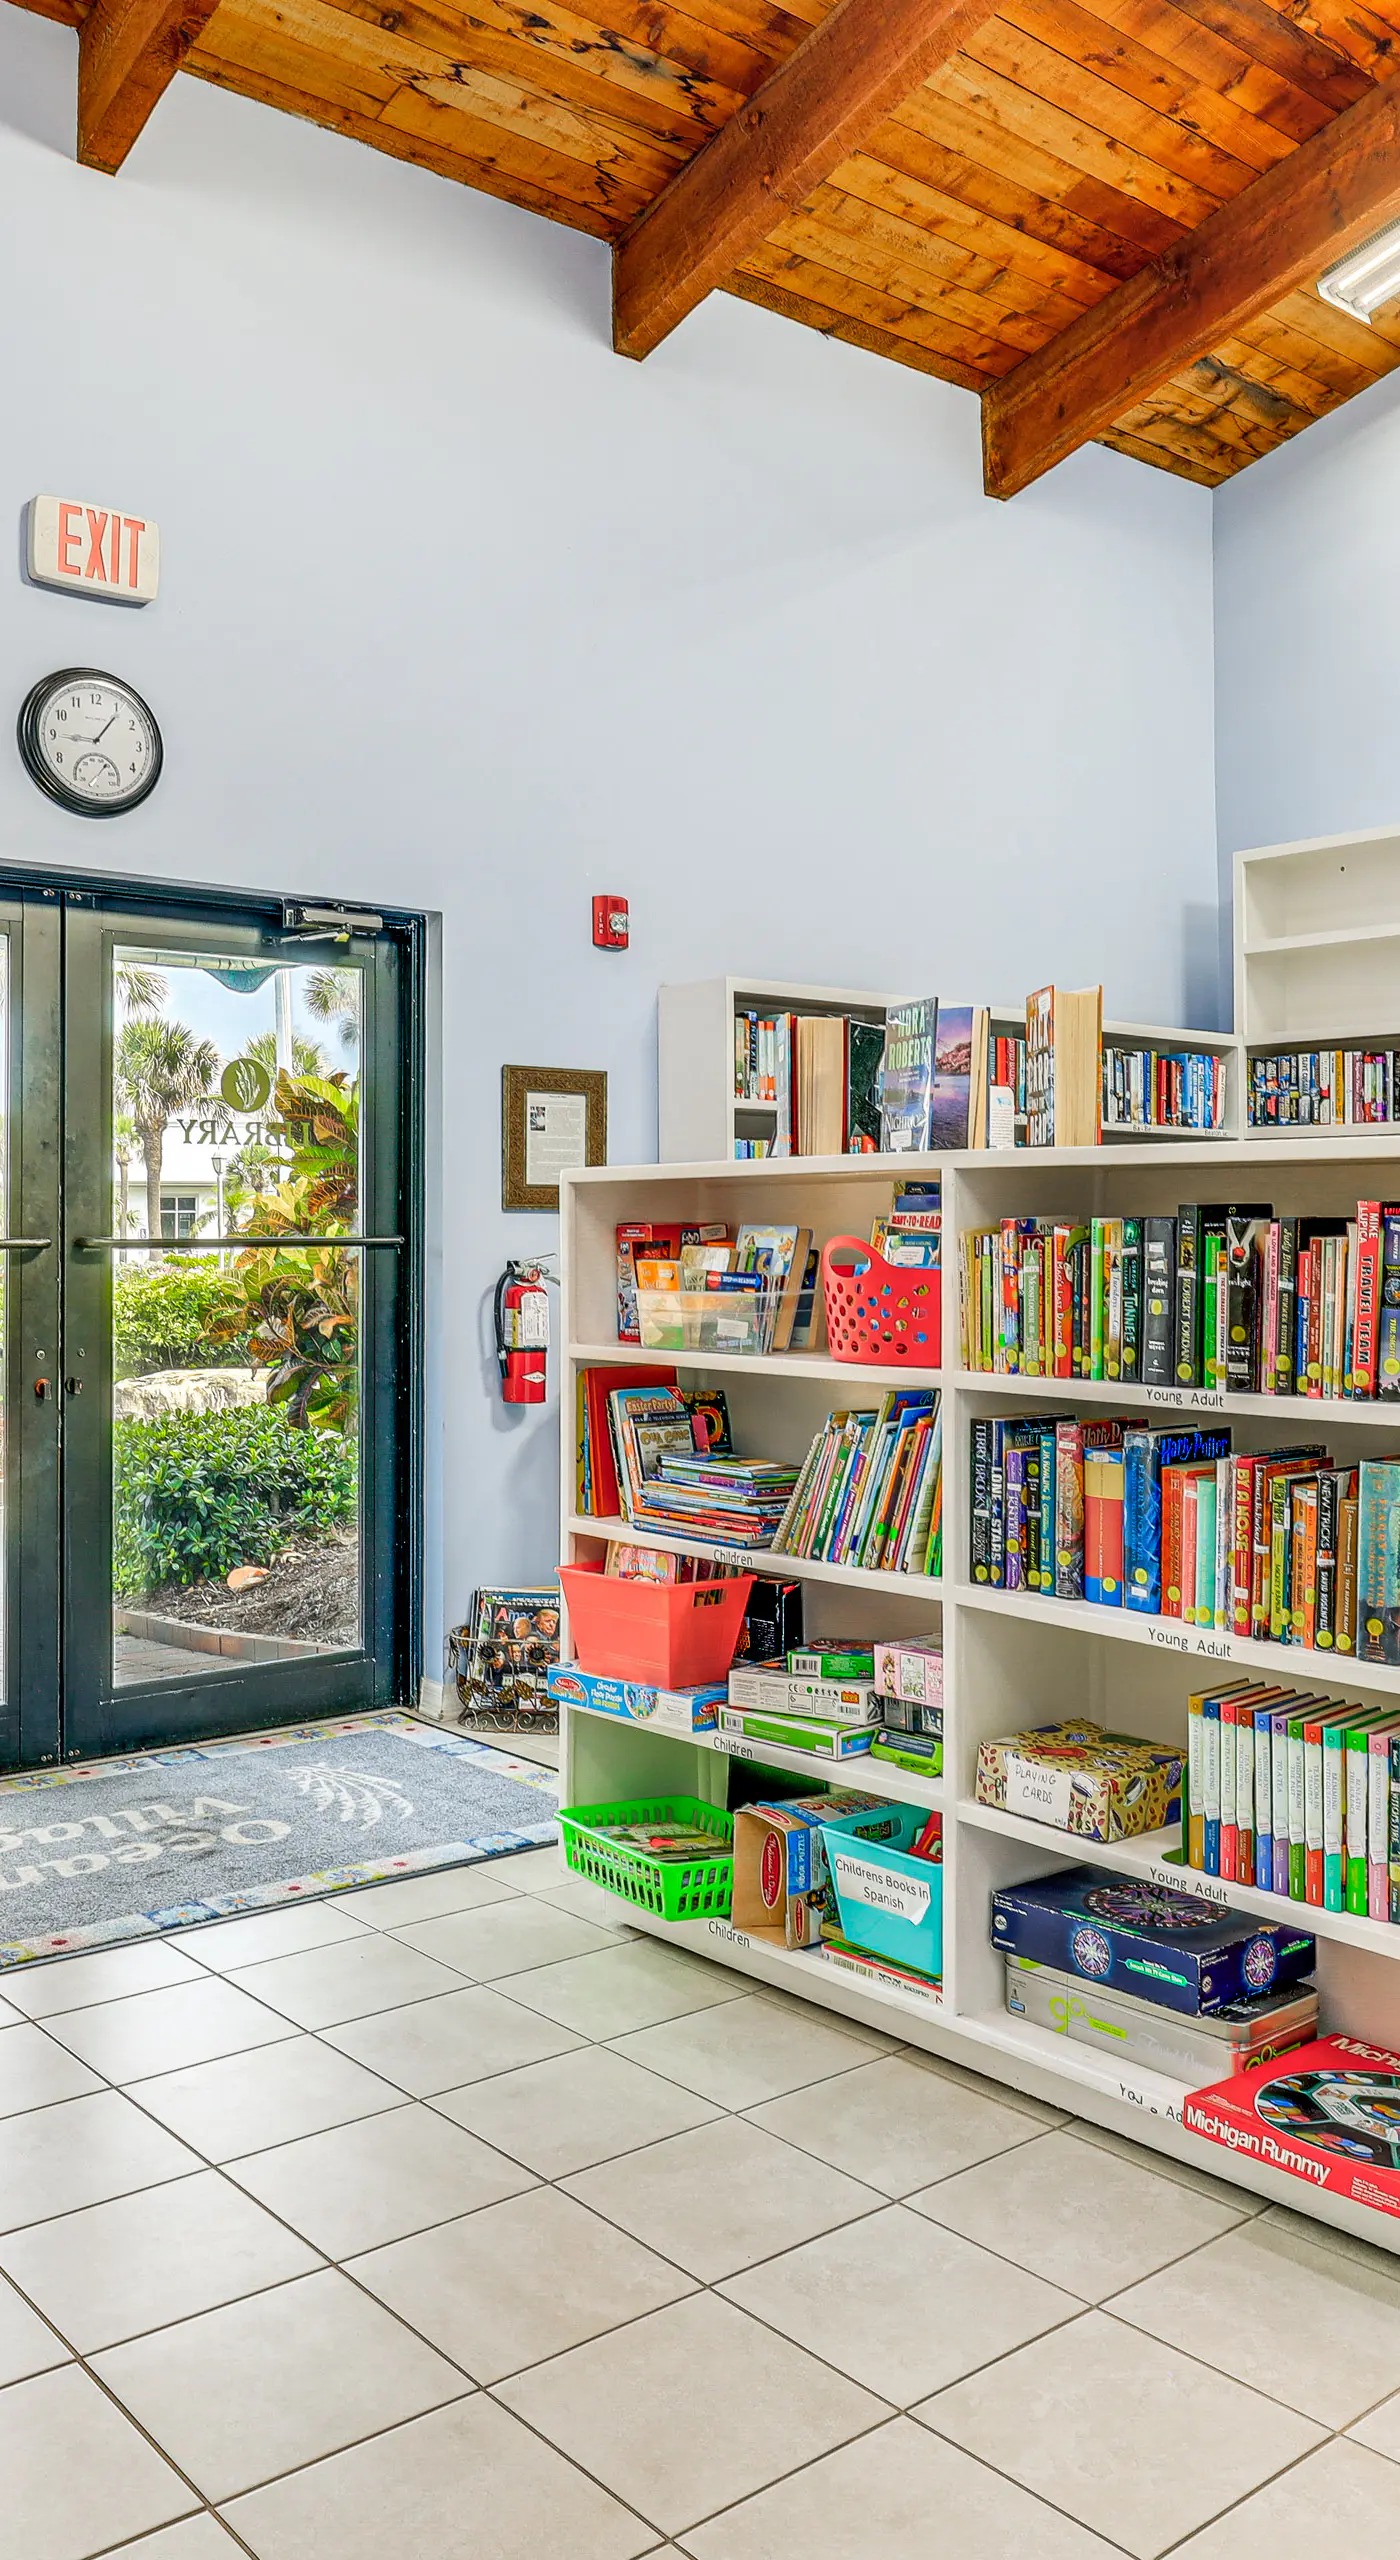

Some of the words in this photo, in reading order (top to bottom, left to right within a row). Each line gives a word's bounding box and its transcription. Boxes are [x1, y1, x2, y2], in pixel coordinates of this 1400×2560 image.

[57, 502, 145, 588] EXIT
[71, 697, 81, 708] 11
[90, 694, 102, 705] 12
[114, 702, 119, 712] 1
[56, 710, 67, 721] 10
[129, 720, 135, 730] 2
[50, 729, 57, 740] 9
[136, 741, 142, 752] 3
[56, 752, 63, 763] 8
[129, 763, 136, 773] 4
[897, 1005, 925, 1038] NORA
[888, 1036, 932, 1070] ROBERTS
[1359, 1207, 1368, 1243] LUPICA
[1369, 1213, 1378, 1238] MIKE
[1182, 1278, 1191, 1318] ROBERT
[1359, 1256, 1373, 1315] TRAVEL
[1122, 1293, 1138, 1343] TUNNELS
[1181, 1320, 1191, 1363] JORDAN
[1358, 1321, 1370, 1364] TEAM
[625, 1399, 651, 1413] Easter
[652, 1398, 677, 1411] Party!
[1146, 1388, 1183, 1406] Young
[1191, 1393, 1224, 1407] Adult
[975, 1424, 987, 1461] TERRY
[1161, 1437, 1193, 1465] Harry
[1193, 1431, 1228, 1458] Potter
[975, 1463, 988, 1509] BROOKS
[991, 1466, 1002, 1501] LONE
[1237, 1469, 1250, 1488] BY
[1236, 1487, 1250, 1502] A
[1320, 1479, 1331, 1511] NEW
[991, 1518, 1002, 1561] STARS
[1236, 1504, 1251, 1551] NOSE
[1321, 1511, 1331, 1549] TRICKS
[714, 1550, 753, 1566] Children
[1320, 1571, 1329, 1592] DAVID
[1148, 1627, 1189, 1651] Young
[1197, 1639, 1232, 1658] Adult
[714, 1736, 754, 1759] Children
[1015, 1764, 1056, 1785] PLAYING
[1022, 1785, 1053, 1804] CARDS
[0, 1796, 252, 1853] Villag
[797, 1833, 805, 1862] PUZZLE
[835, 1858, 884, 1885] Childrens
[885, 1876, 917, 1896] Books
[918, 1886, 930, 1900] In
[1149, 1867, 1188, 1894] Young
[1195, 1882, 1228, 1904] Adult
[863, 1887, 905, 1912] Spanish
[708, 1921, 751, 1948] Children
[1187, 2104, 1261, 2153] Michigan
[1262, 2135, 1331, 2186] Rummy
